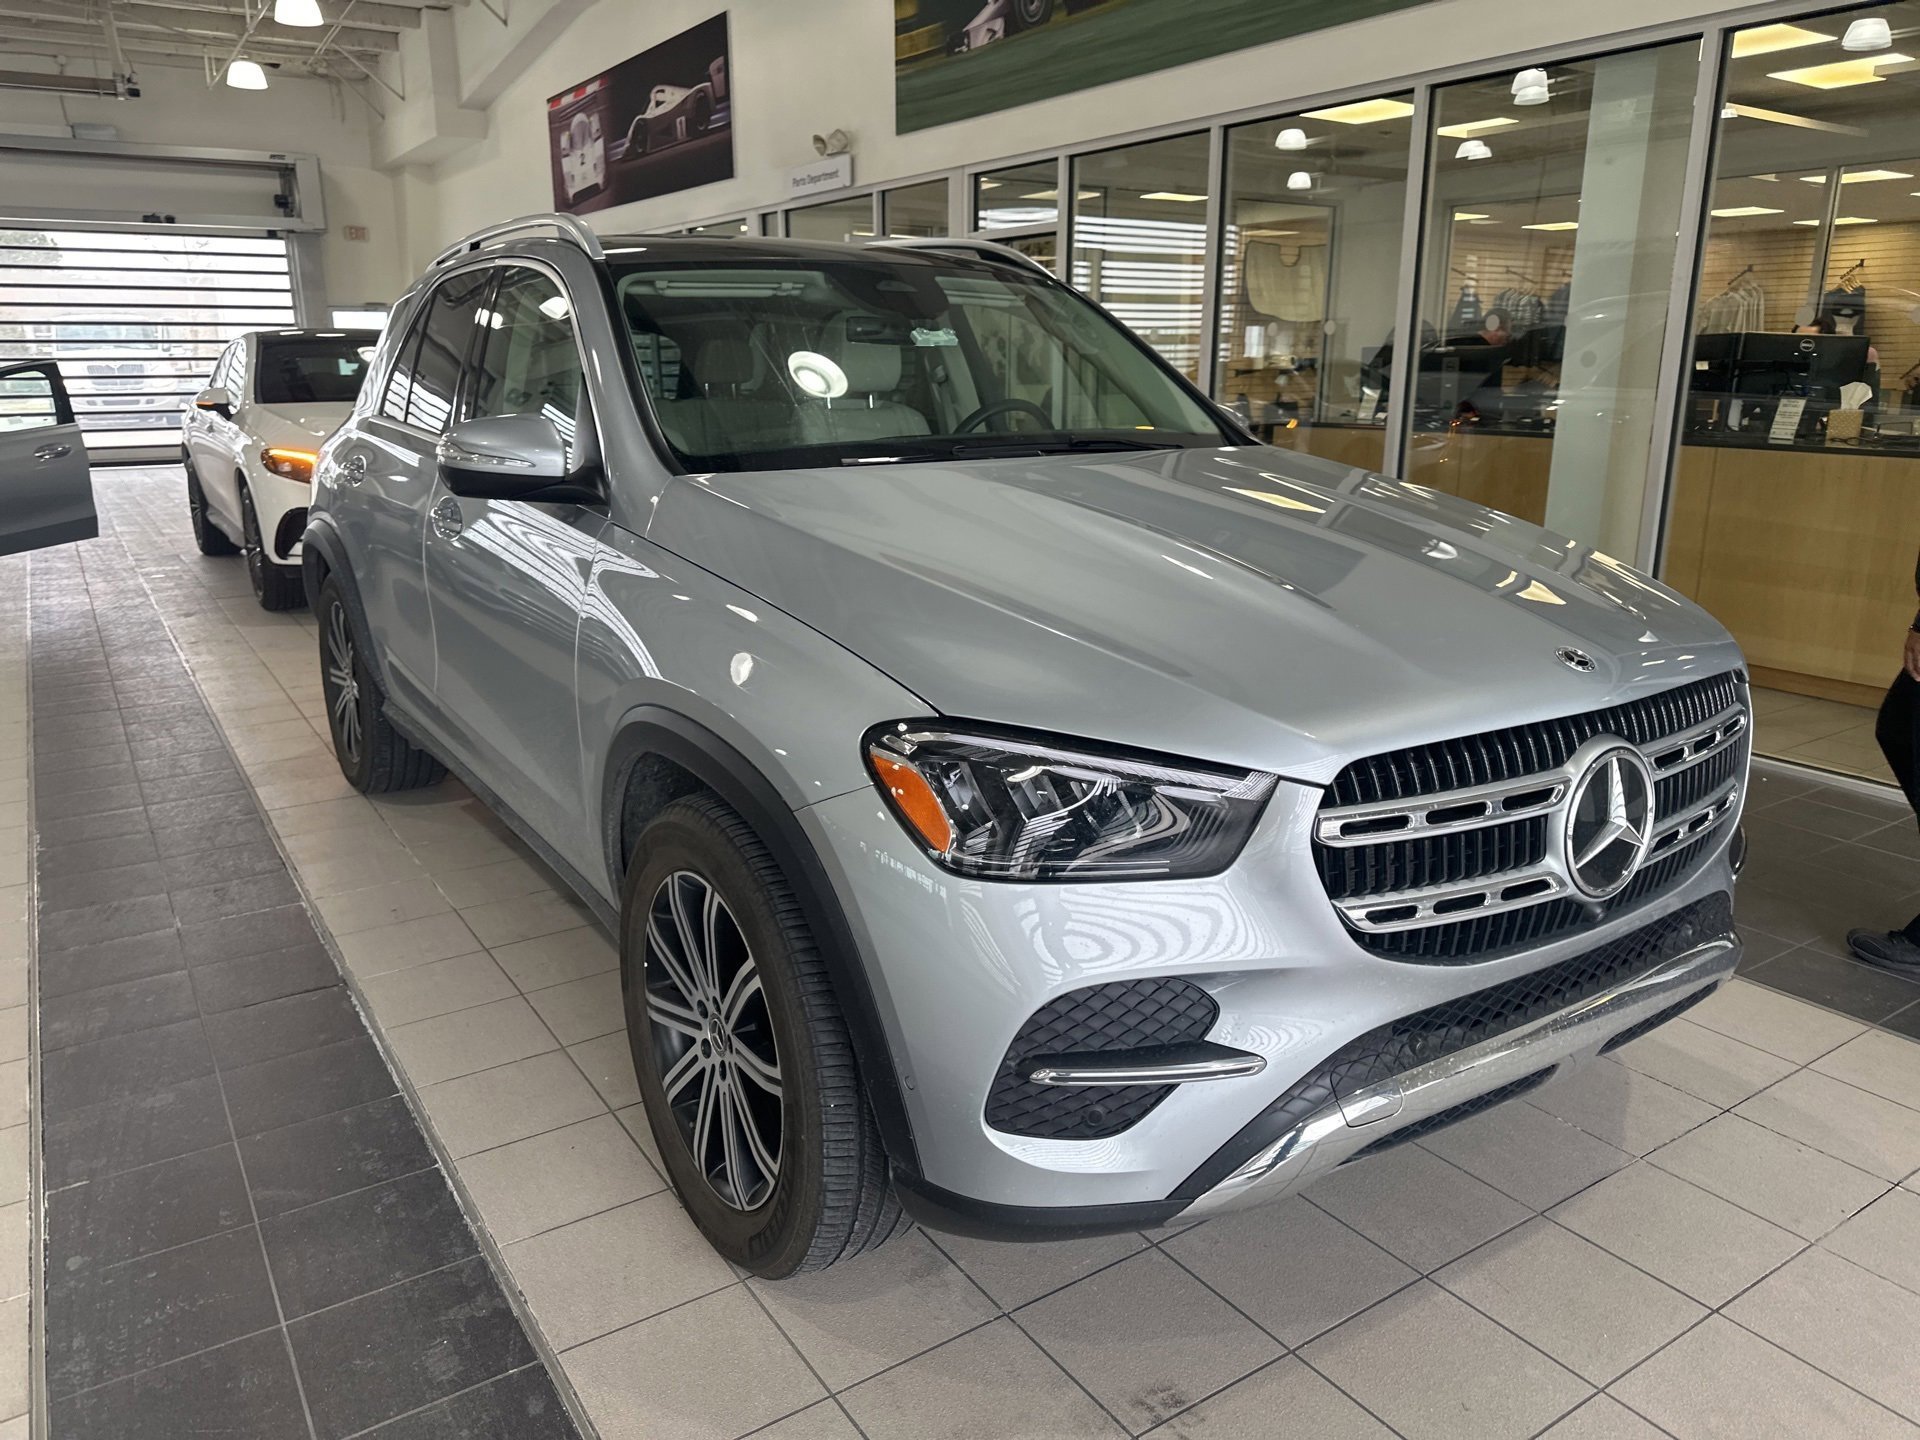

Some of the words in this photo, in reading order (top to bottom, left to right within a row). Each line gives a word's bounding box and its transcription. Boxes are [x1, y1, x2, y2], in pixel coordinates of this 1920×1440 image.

[579, 152, 586, 166] 2
[792, 177, 806, 187] Parts
[807, 168, 839, 185] Department
